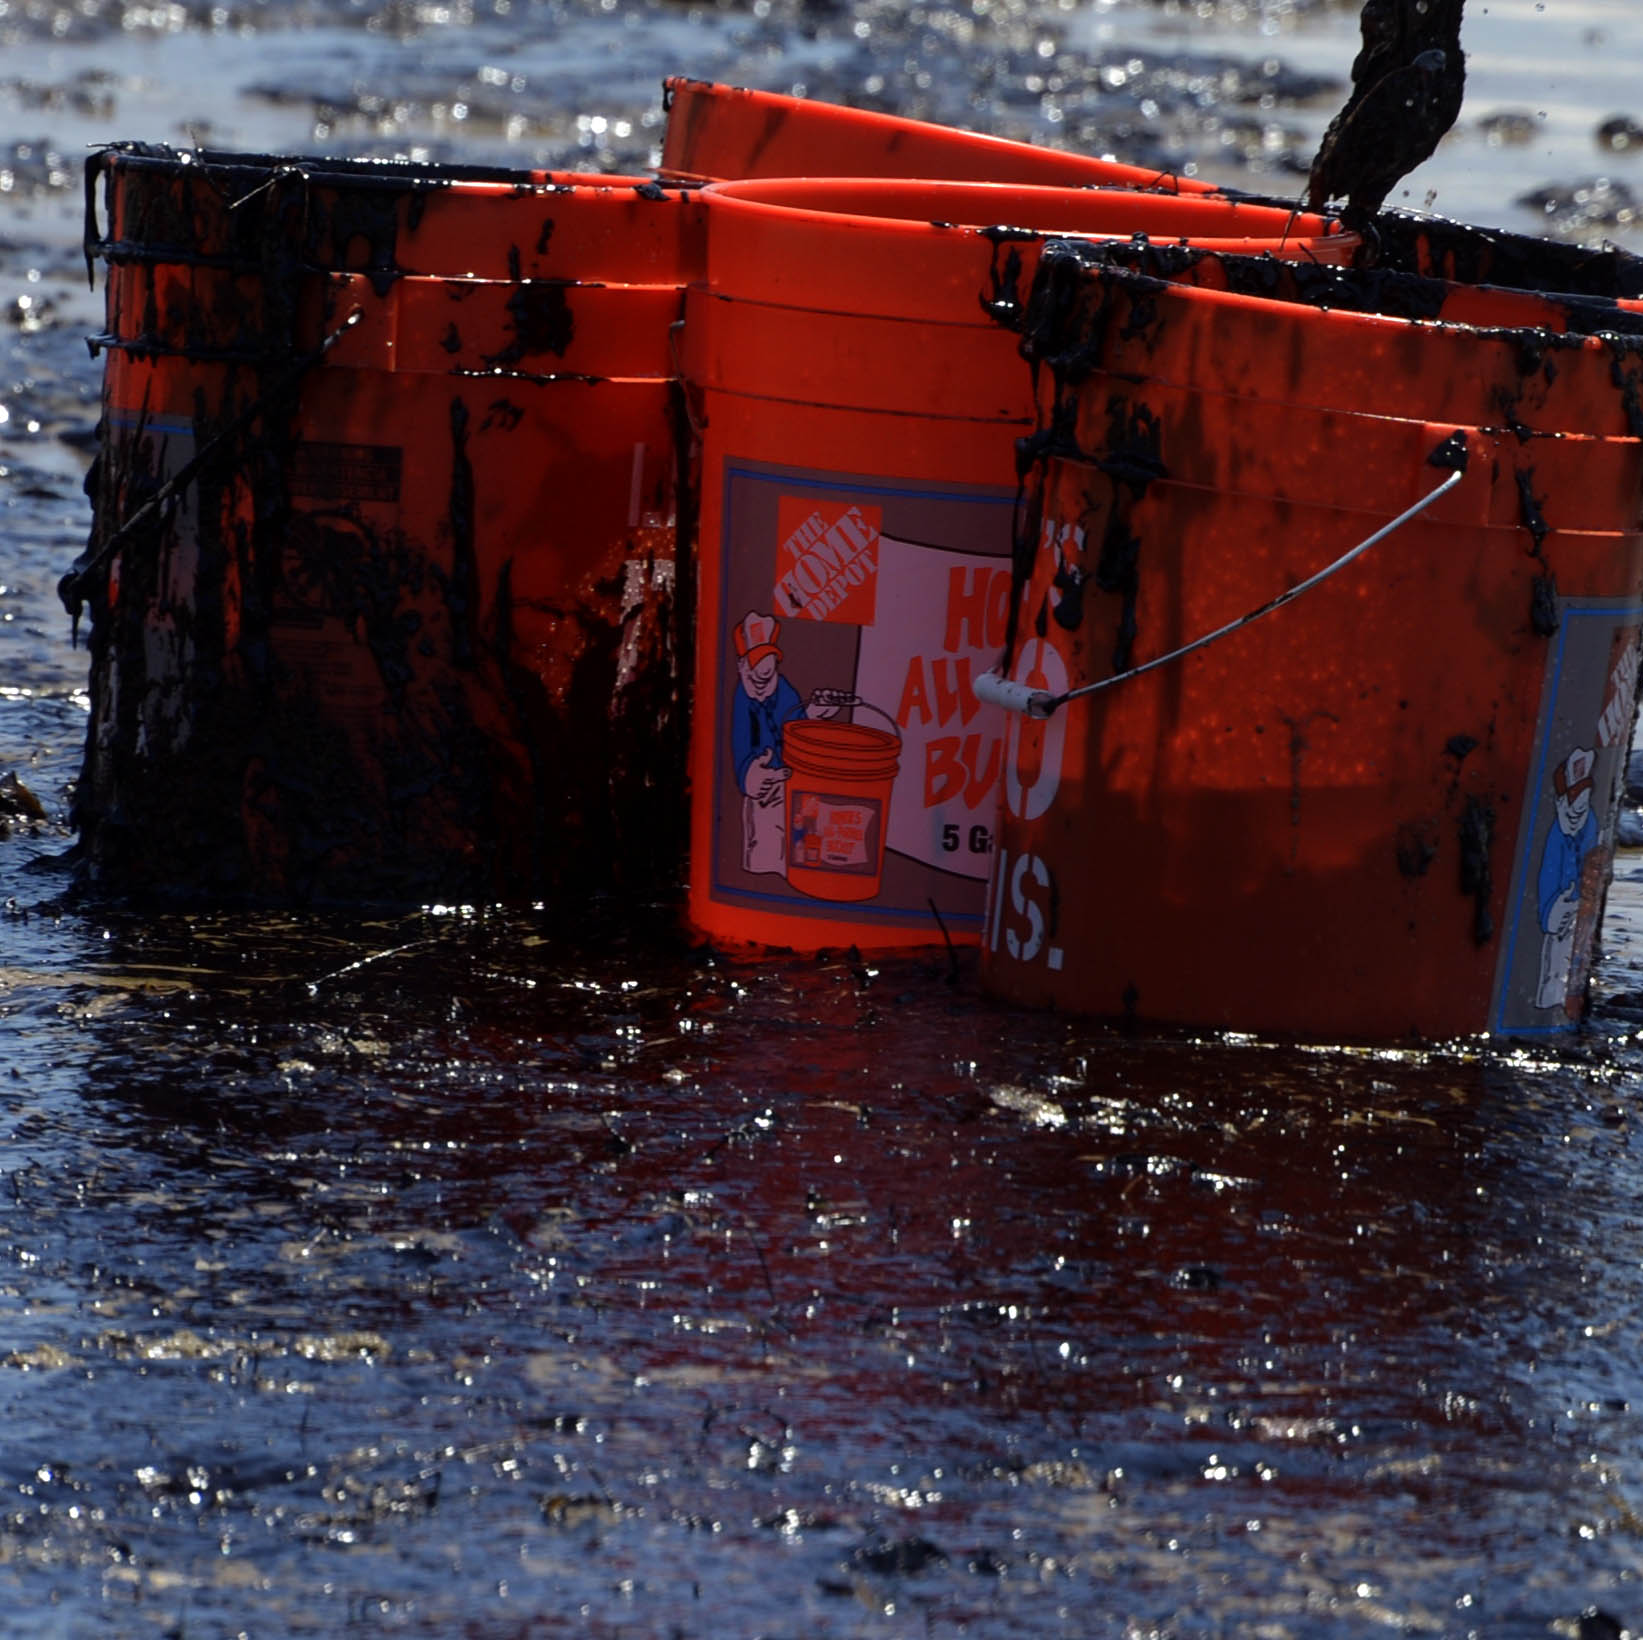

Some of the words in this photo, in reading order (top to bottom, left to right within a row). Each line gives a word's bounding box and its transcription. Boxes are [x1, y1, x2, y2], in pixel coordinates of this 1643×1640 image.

[773, 506, 879, 617] HOME
[783, 511, 829, 561] THE
[806, 550, 877, 621] DEPOT
[944, 566, 1013, 652] HO
[896, 656, 981, 729] ALL
[924, 733, 1002, 810] BU
[942, 824, 959, 852] 5
